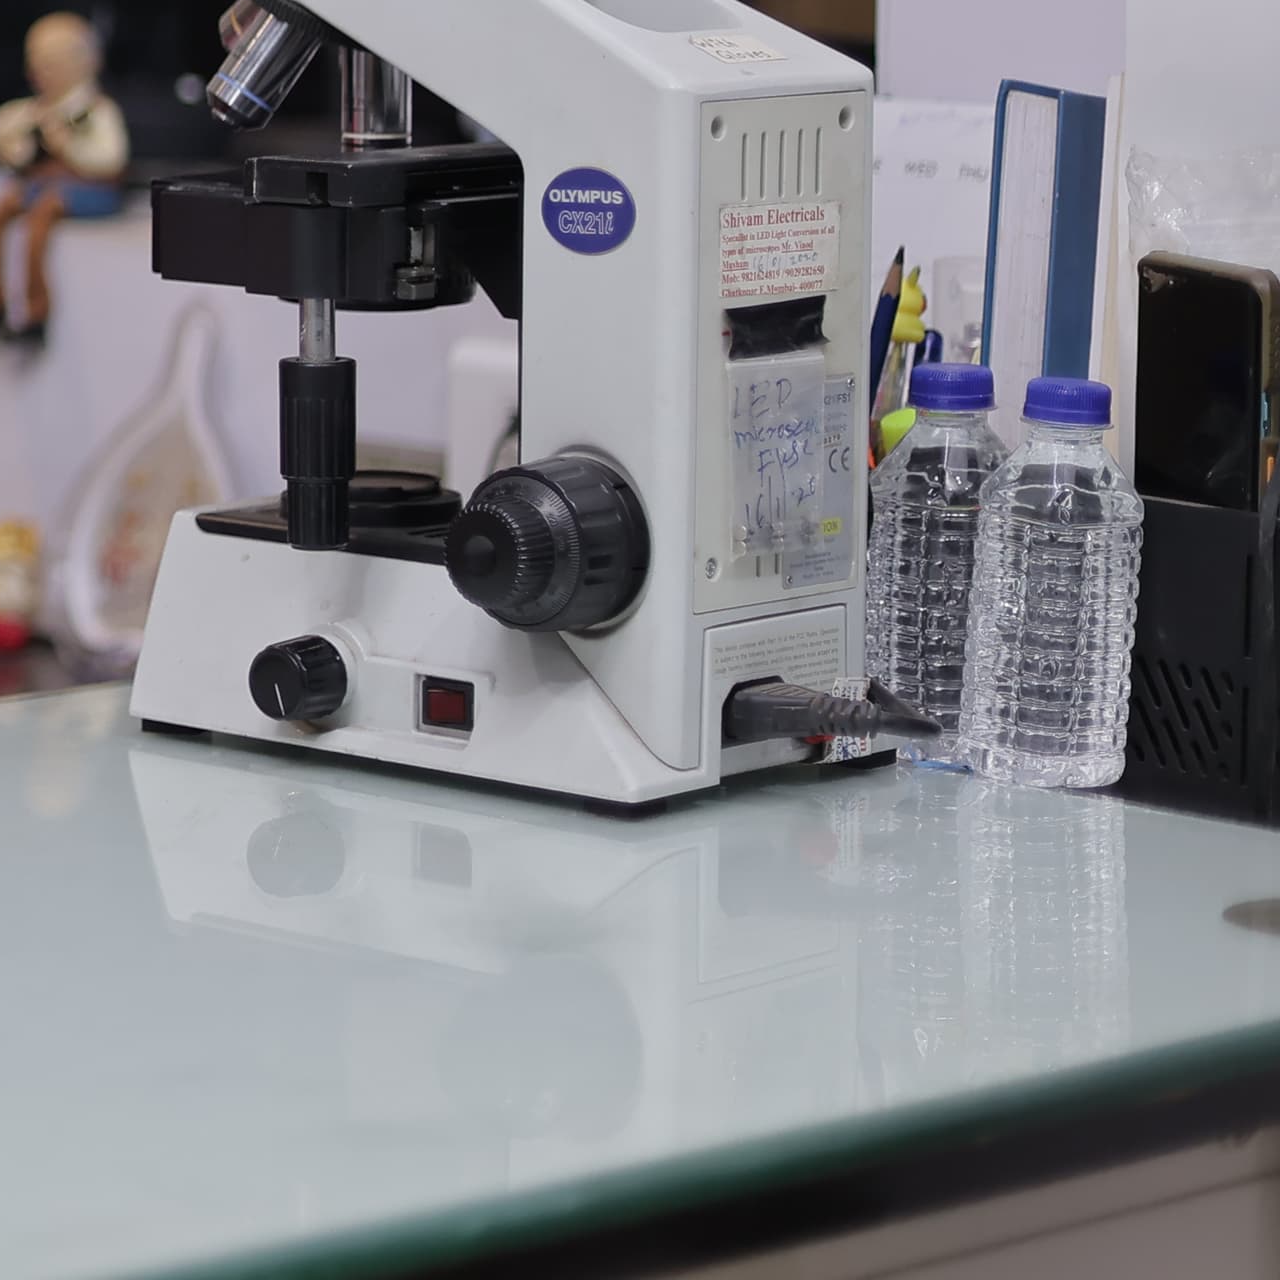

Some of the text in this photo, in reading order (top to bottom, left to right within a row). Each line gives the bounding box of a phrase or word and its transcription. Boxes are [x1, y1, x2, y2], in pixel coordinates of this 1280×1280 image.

[549, 189, 624, 204] OLYMPUS
[558, 210, 614, 235] CX21i
[722, 205, 825, 229] Shivam Electricals
[757, 231, 770, 240] LED
[771, 230, 786, 241] Light
[734, 378, 792, 419] LED
